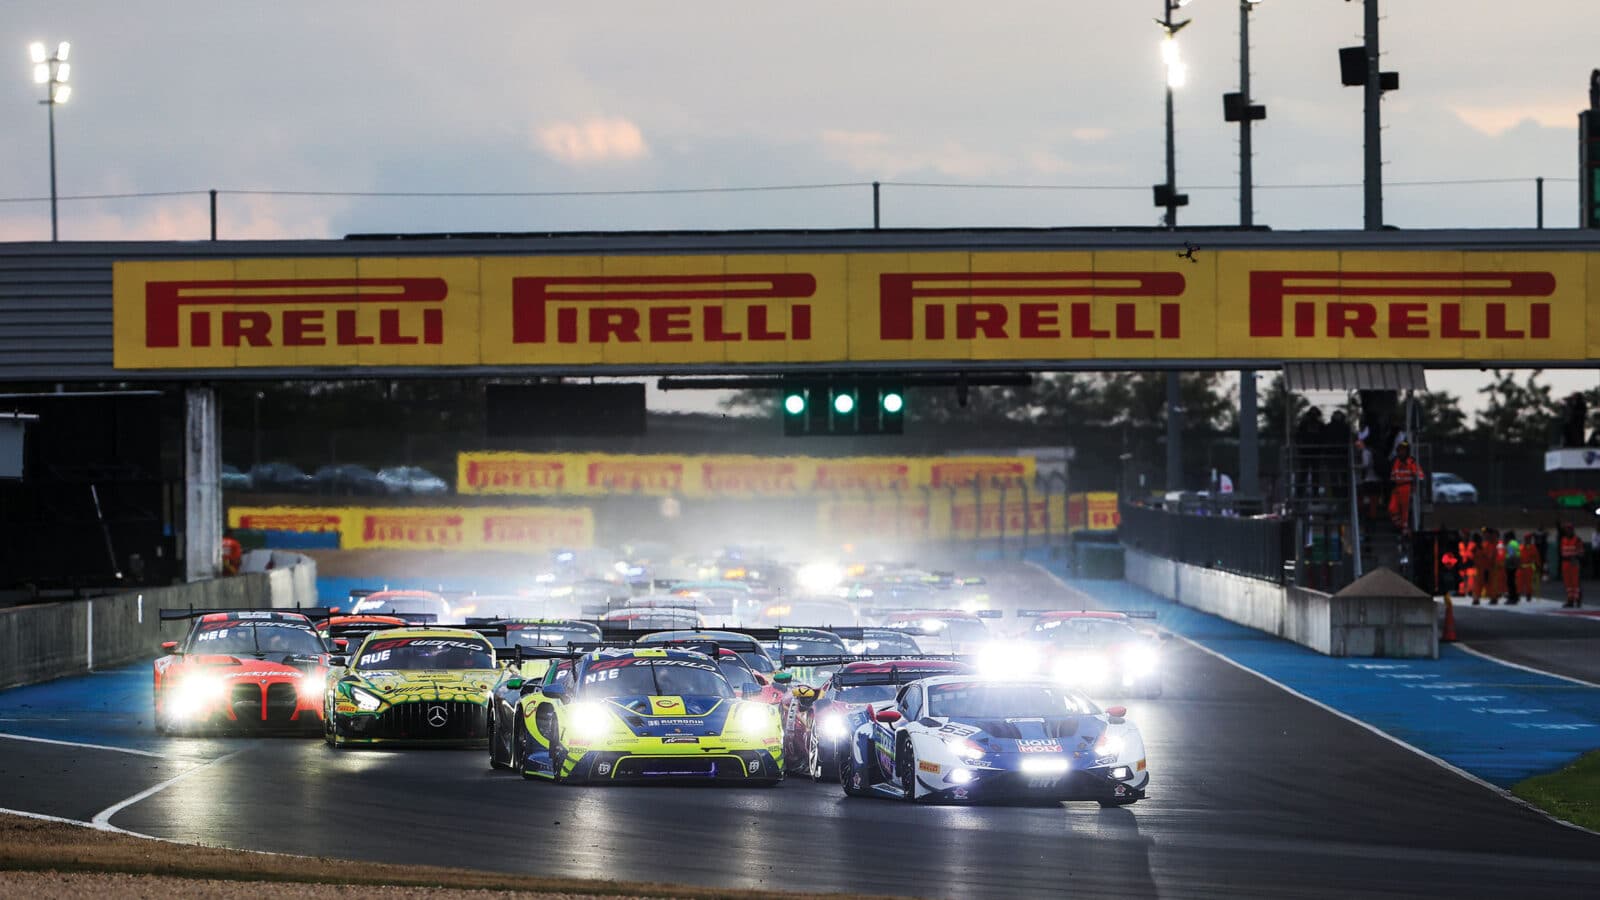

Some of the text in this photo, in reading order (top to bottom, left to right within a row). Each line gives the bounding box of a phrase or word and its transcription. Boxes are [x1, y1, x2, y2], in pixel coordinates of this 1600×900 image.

[145, 277, 448, 348] PIRELLI
[512, 272, 817, 344] PIRELLI
[879, 270, 1186, 340] PIRELLI
[1249, 270, 1557, 339] PIRELLI
[239, 621, 312, 630] WORLD
[409, 639, 484, 651] WORLD
[633, 659, 717, 672] WORLD
[585, 668, 620, 684] NIE
[1019, 745, 1060, 753] MOLY
